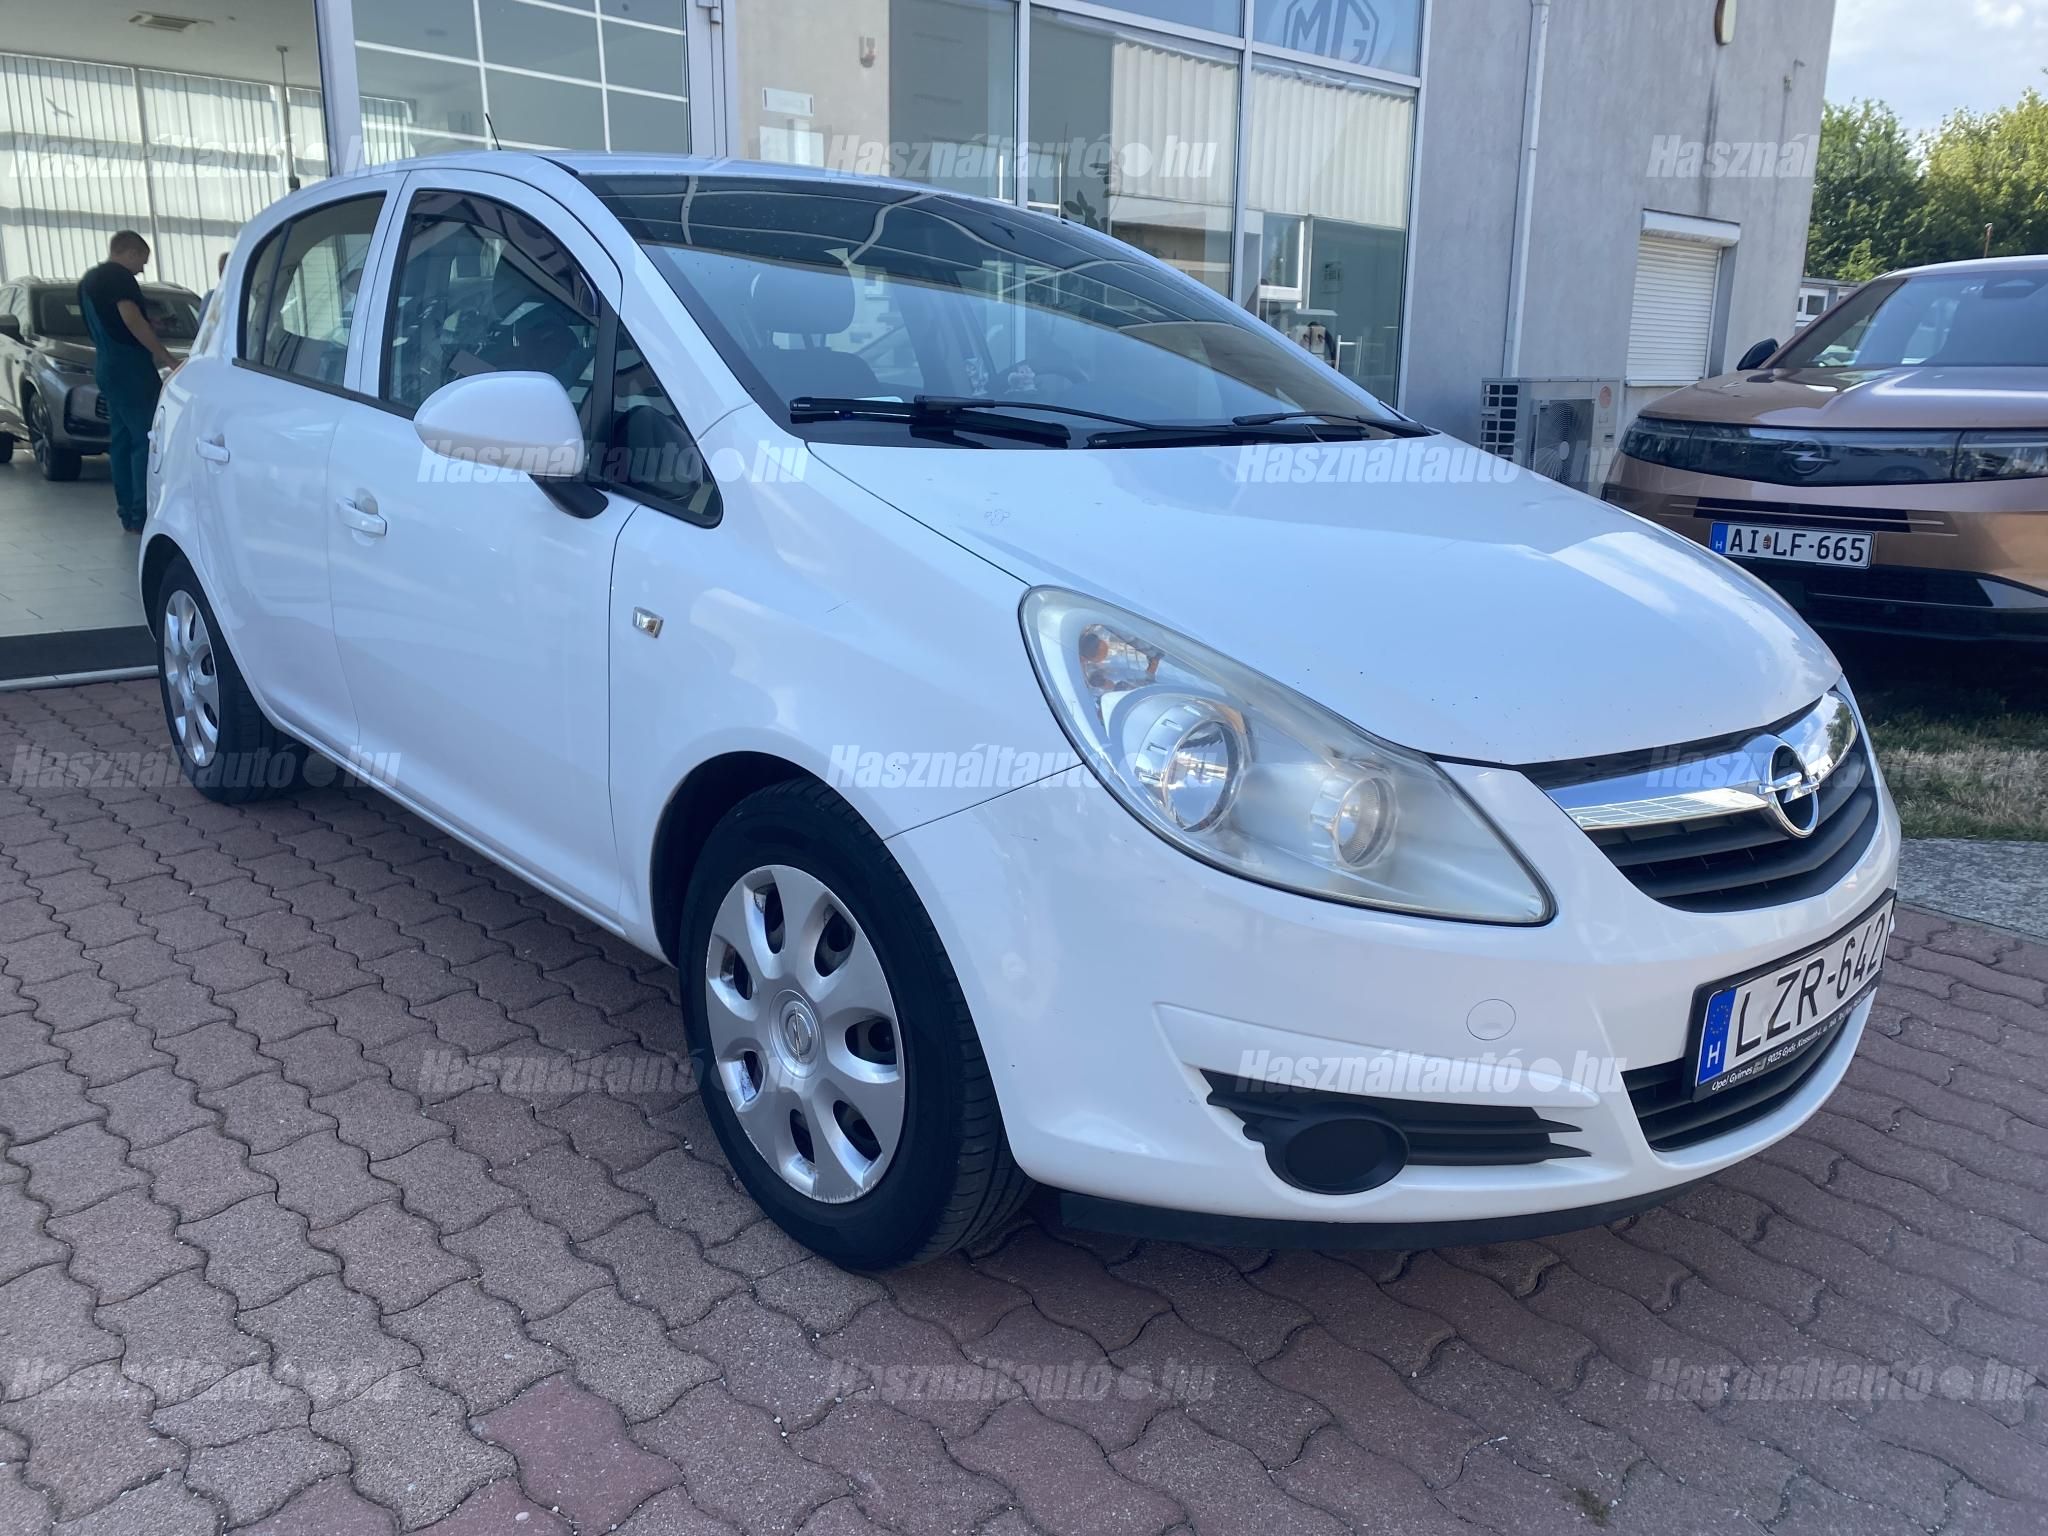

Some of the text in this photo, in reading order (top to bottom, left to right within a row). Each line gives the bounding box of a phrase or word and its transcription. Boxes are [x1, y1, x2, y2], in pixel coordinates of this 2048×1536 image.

[1290, 0, 1370, 64] MG
[1715, 541, 1723, 550] H
[1734, 911, 1886, 1058] LZR-642
[1706, 1040, 1722, 1069] H
